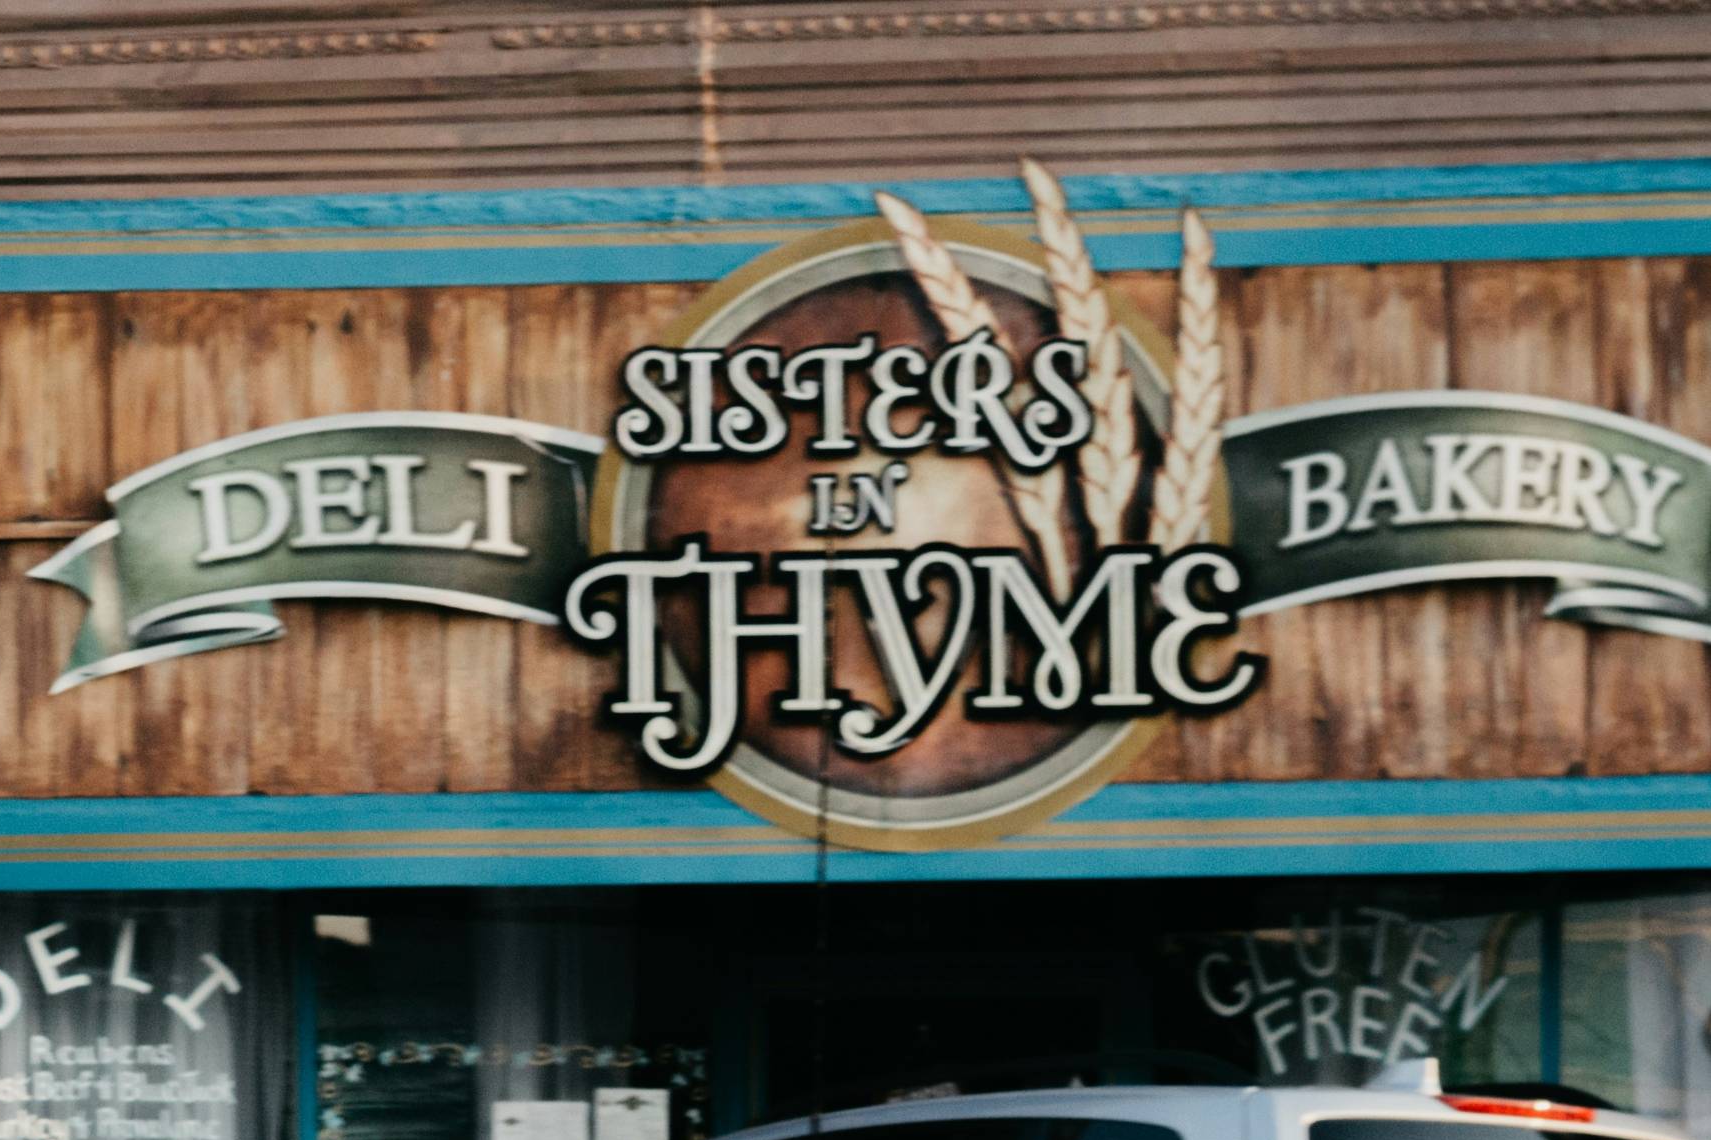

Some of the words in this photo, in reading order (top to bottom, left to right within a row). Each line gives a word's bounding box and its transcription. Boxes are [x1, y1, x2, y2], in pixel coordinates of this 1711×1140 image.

[615, 332, 1090, 467] SISTERS
[189, 454, 529, 565] DELI
[810, 461, 907, 533] IN
[1279, 434, 1680, 547] BAKERY
[566, 542, 1255, 771] THYME
[1197, 907, 1508, 1030] GLUTEN
